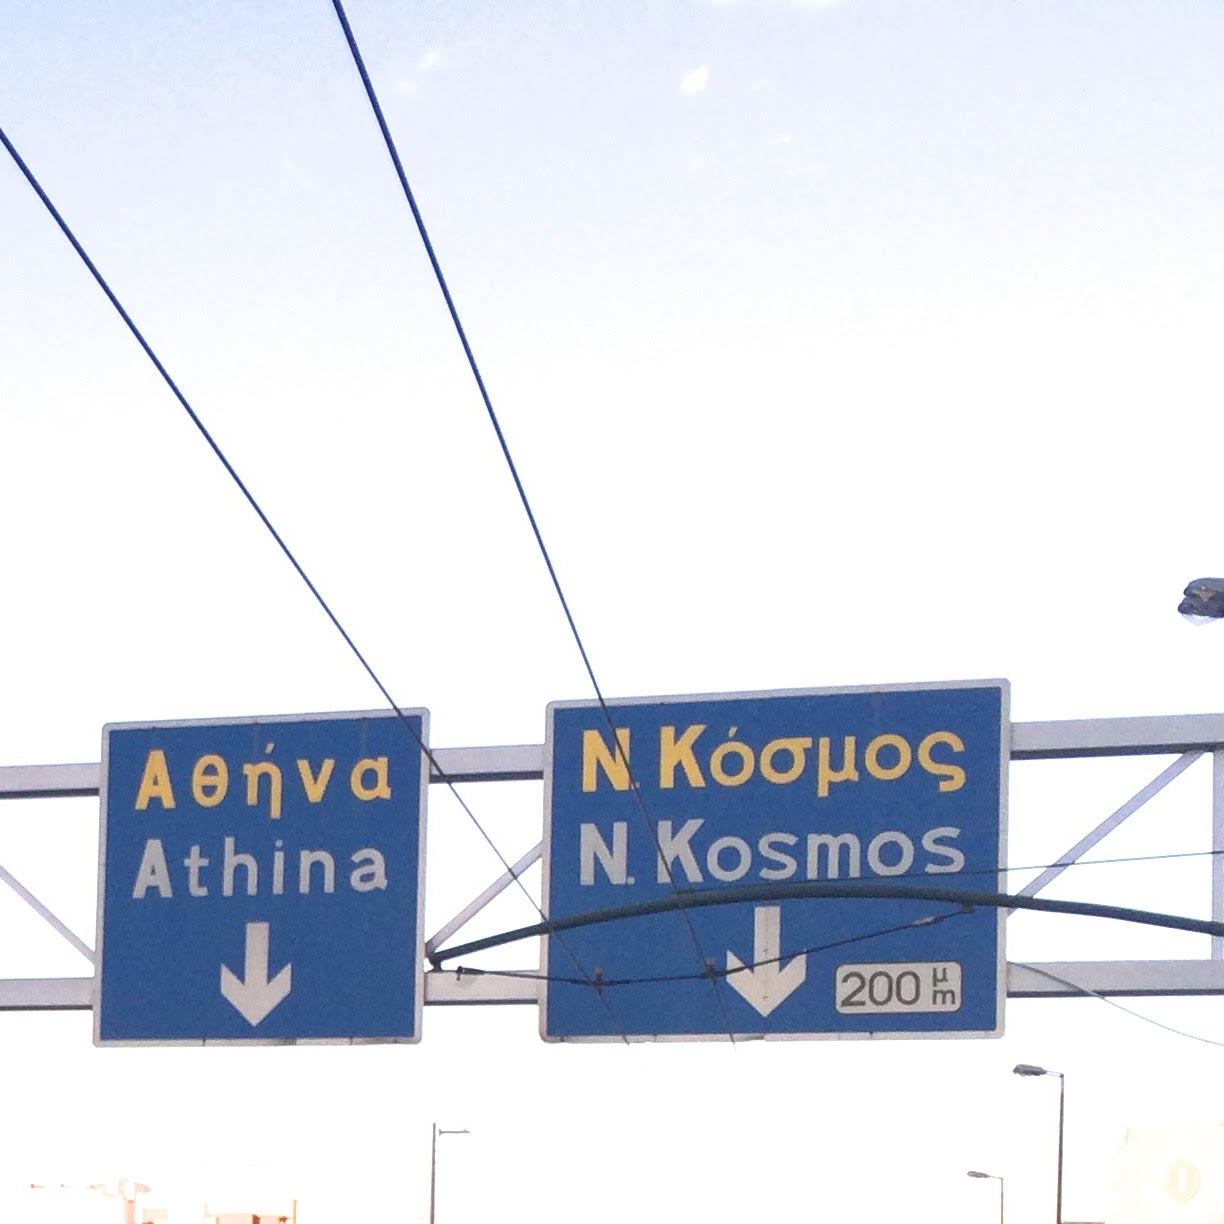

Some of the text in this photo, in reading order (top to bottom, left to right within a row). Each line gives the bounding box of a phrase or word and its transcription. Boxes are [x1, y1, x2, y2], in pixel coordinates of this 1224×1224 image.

[135, 742, 392, 819] Αθήνα
[660, 723, 967, 797] Κόσμος
[132, 836, 388, 899] Athina
[579, 818, 966, 886] N. Kosmos
[841, 971, 921, 1007] 200
